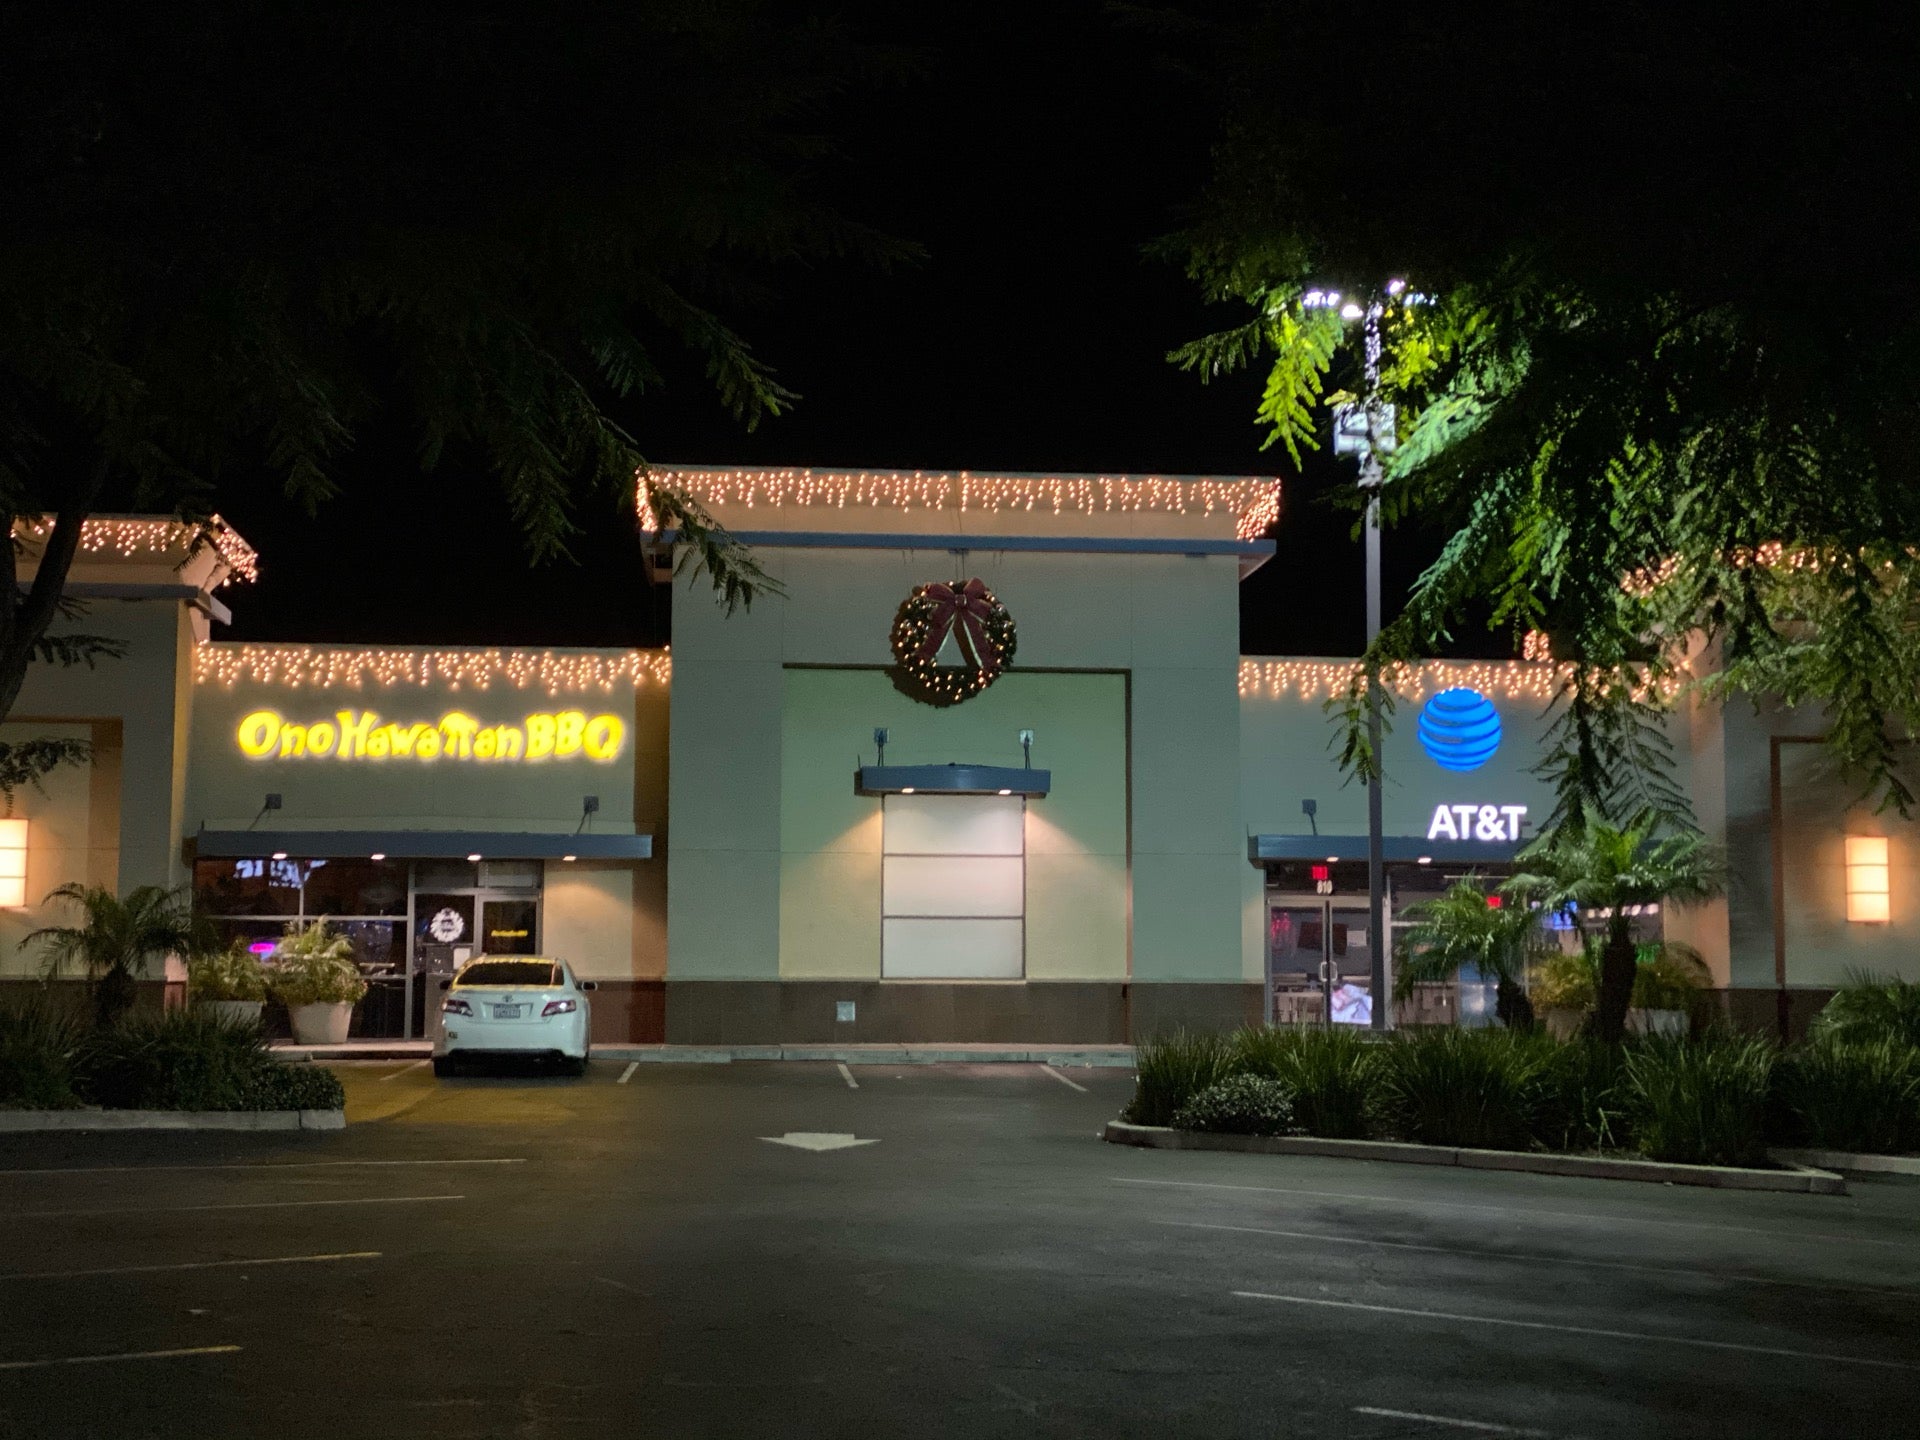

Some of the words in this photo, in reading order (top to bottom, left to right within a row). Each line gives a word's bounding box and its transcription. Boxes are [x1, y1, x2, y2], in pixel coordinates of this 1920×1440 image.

[238, 710, 334, 758] Ono
[525, 711, 623, 759] BBQ
[1427, 804, 1528, 841] AT&T
